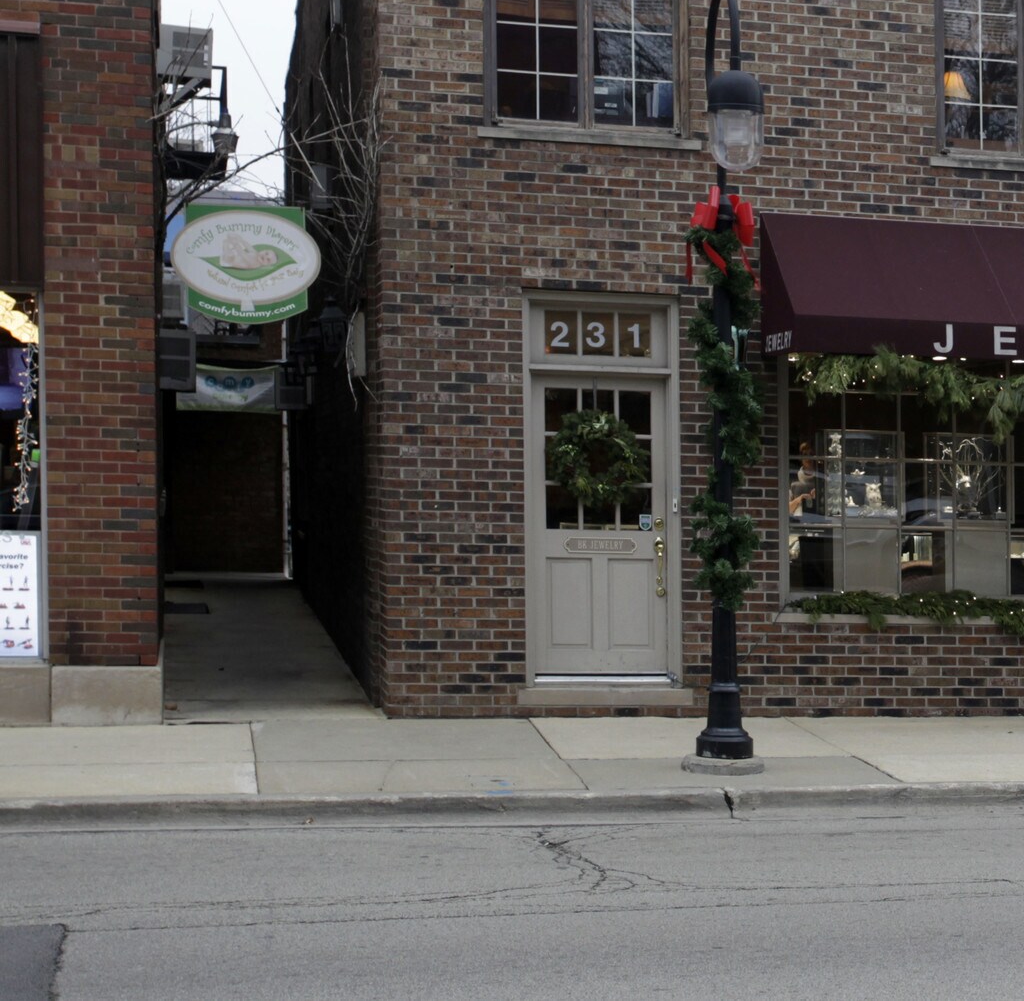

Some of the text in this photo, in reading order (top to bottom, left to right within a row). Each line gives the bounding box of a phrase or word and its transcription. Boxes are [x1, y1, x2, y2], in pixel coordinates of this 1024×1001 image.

[186, 228, 214, 255] Comfy
[215, 222, 263, 236] Bummy
[198, 301, 296, 318] comfybummy.com
[550, 321, 640, 348] 231
[765, 330, 792, 353] JEWELRY
[578, 540, 624, 550] BK JEWELRY
